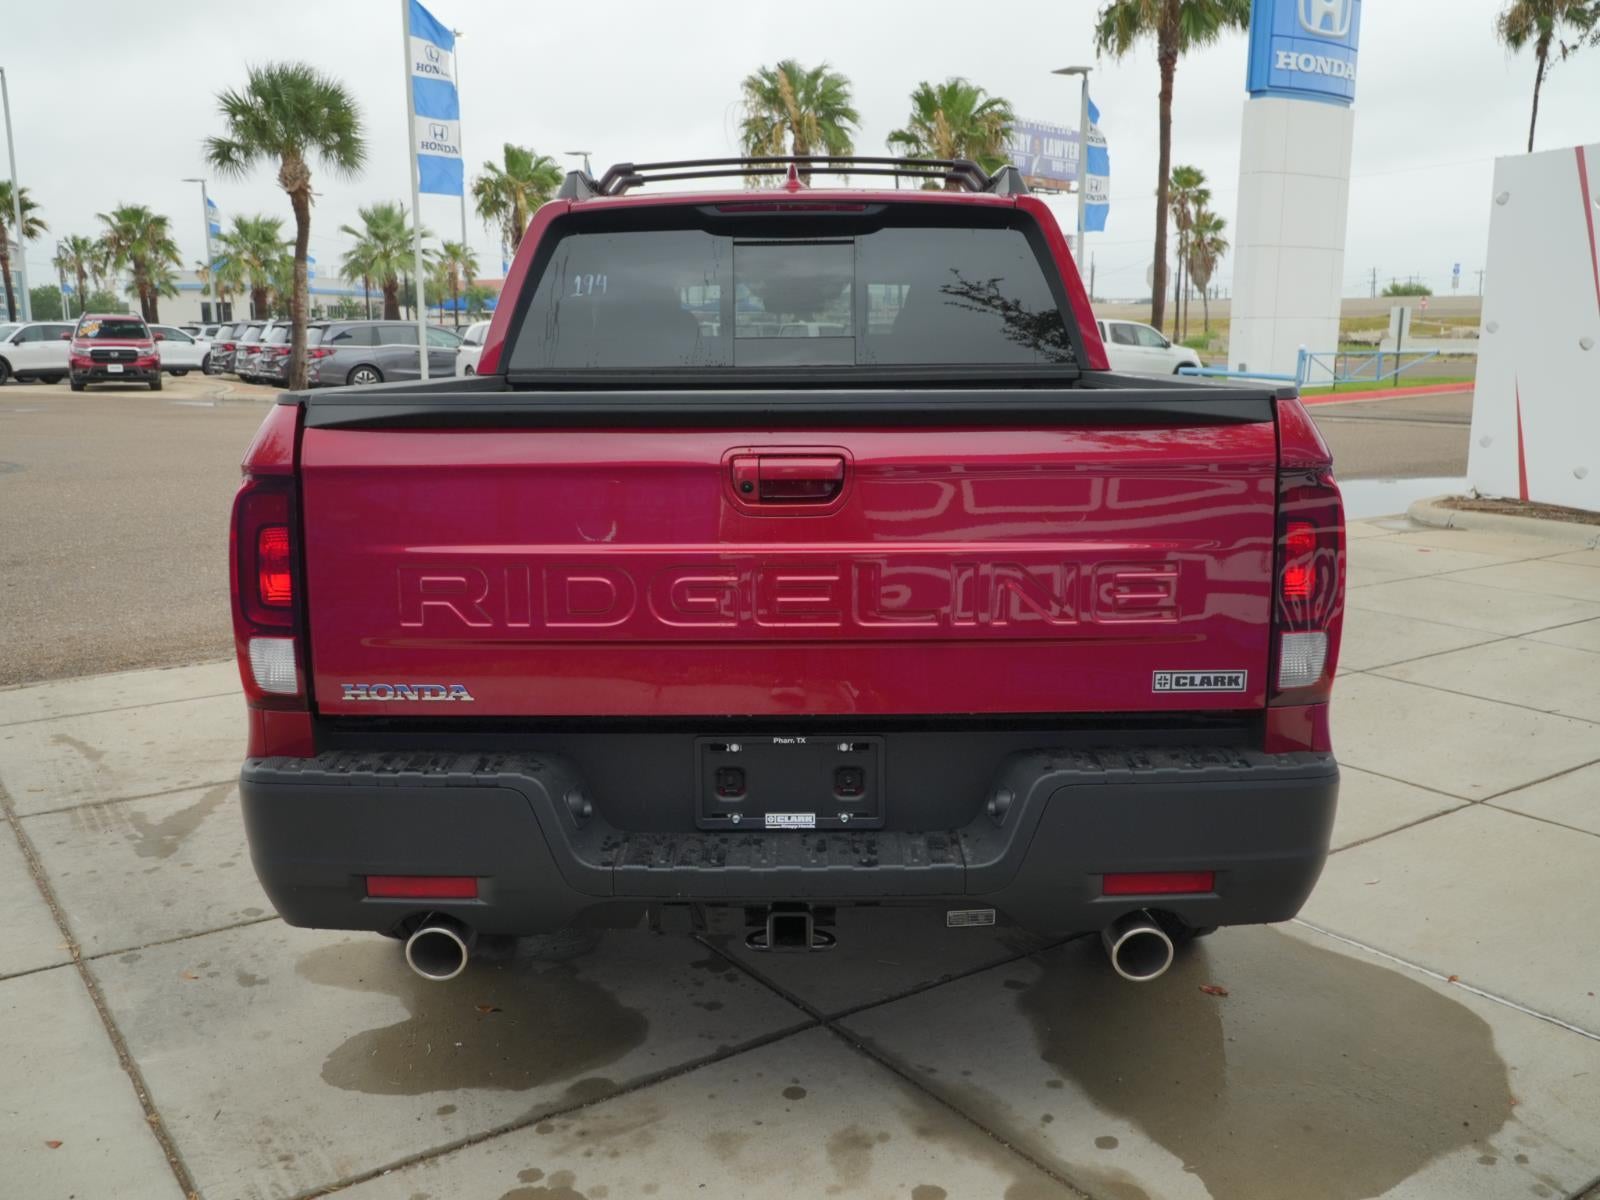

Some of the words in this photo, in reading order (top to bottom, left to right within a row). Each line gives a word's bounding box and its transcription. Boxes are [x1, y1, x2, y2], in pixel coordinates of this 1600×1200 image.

[1275, 50, 1356, 81] HONDA
[421, 141, 459, 154] HONDA
[397, 562, 1182, 628] RIDGELINE
[1174, 675, 1241, 687] CLARK
[341, 683, 475, 701] HONDA
[777, 815, 814, 823] CLARK
